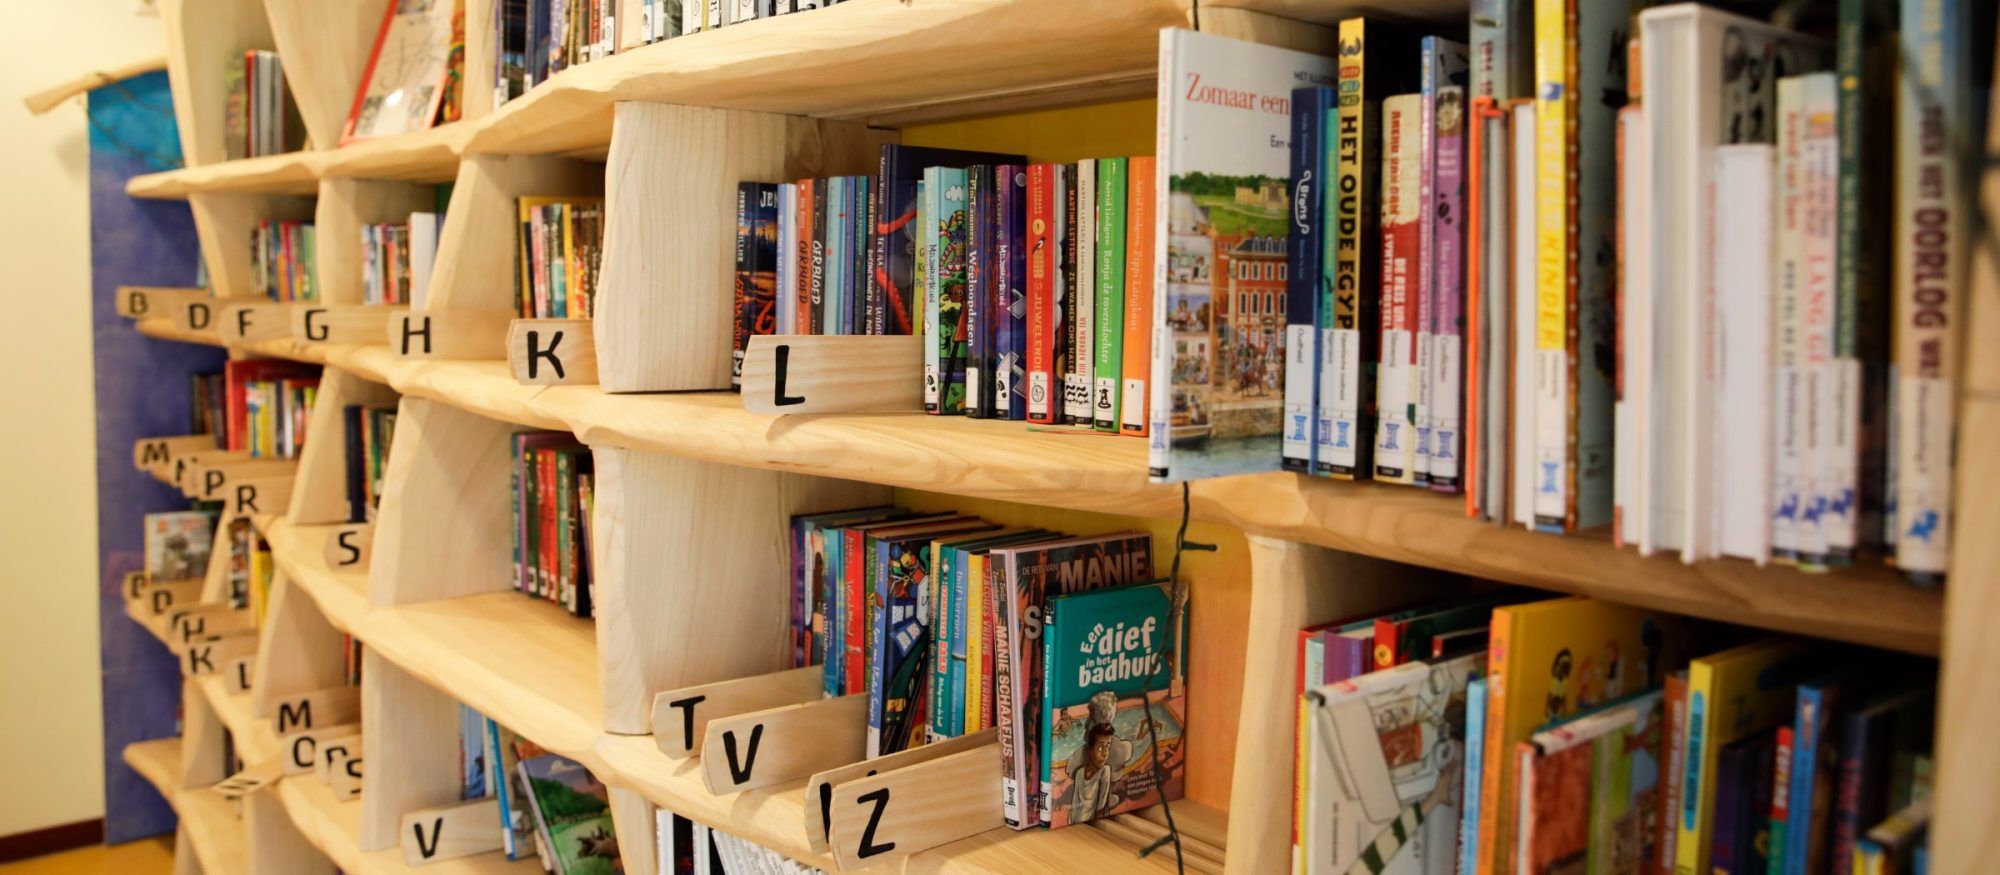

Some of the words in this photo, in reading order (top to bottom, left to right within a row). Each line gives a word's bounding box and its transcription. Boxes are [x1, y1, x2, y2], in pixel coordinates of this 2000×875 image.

[1186, 72, 1256, 111] Zomaar
[1260, 94, 1290, 116] een
[1270, 135, 1285, 148] Een
[1340, 115, 1357, 165] HET
[738, 190, 746, 227] JENNIFER
[1104, 180, 1112, 207] Astrid
[1134, 180, 1143, 206] Astrid
[1298, 183, 1309, 223] Brons
[1339, 174, 1356, 251] OUDE
[1068, 227, 1076, 264] LETTERIE
[1103, 207, 1112, 246] Lindgren
[1133, 207, 1143, 247] Lindgren
[799, 240, 808, 304] OERBLOED
[812, 240, 822, 305] OERBLOED
[1068, 271, 1075, 282] ZE
[1101, 249, 1112, 281] Ronja
[1131, 249, 1142, 278] Pippi
[1394, 257, 1406, 274] DE
[1912, 207, 1949, 329] OORLOG
[130, 293, 147, 313] B
[967, 249, 977, 347] Wegloopdagen
[1102, 282, 1112, 294] de
[1338, 260, 1355, 329] EGYP
[189, 303, 209, 330] D
[237, 309, 254, 336] F
[304, 308, 329, 341] G
[401, 316, 432, 355] H
[1101, 296, 1112, 363] roversdochter
[526, 330, 565, 380] K
[774, 344, 806, 406] L
[142, 442, 169, 464] M
[205, 470, 225, 496] P
[237, 485, 258, 513] R
[338, 531, 360, 566] S
[955, 571, 964, 594] Dolf
[1022, 567, 1030, 576] DE
[1031, 565, 1044, 575] REIS
[1060, 550, 1146, 595] MANIE
[982, 574, 992, 618] JACQUES
[953, 596, 963, 640] Verroen
[1098, 616, 1156, 656] dief
[982, 620, 991, 656] VRIENS
[996, 625, 1010, 672] MANIE
[1080, 622, 1104, 654] Een
[190, 646, 214, 674] K
[1078, 646, 1162, 688] badhuis
[1086, 657, 1095, 668] in
[1096, 656, 1112, 666] het
[279, 699, 312, 733] M
[669, 695, 706, 751] T
[998, 675, 1013, 759] SCHAAFIJS
[722, 723, 764, 785] V
[413, 816, 444, 860] V
[856, 787, 896, 860] Z
